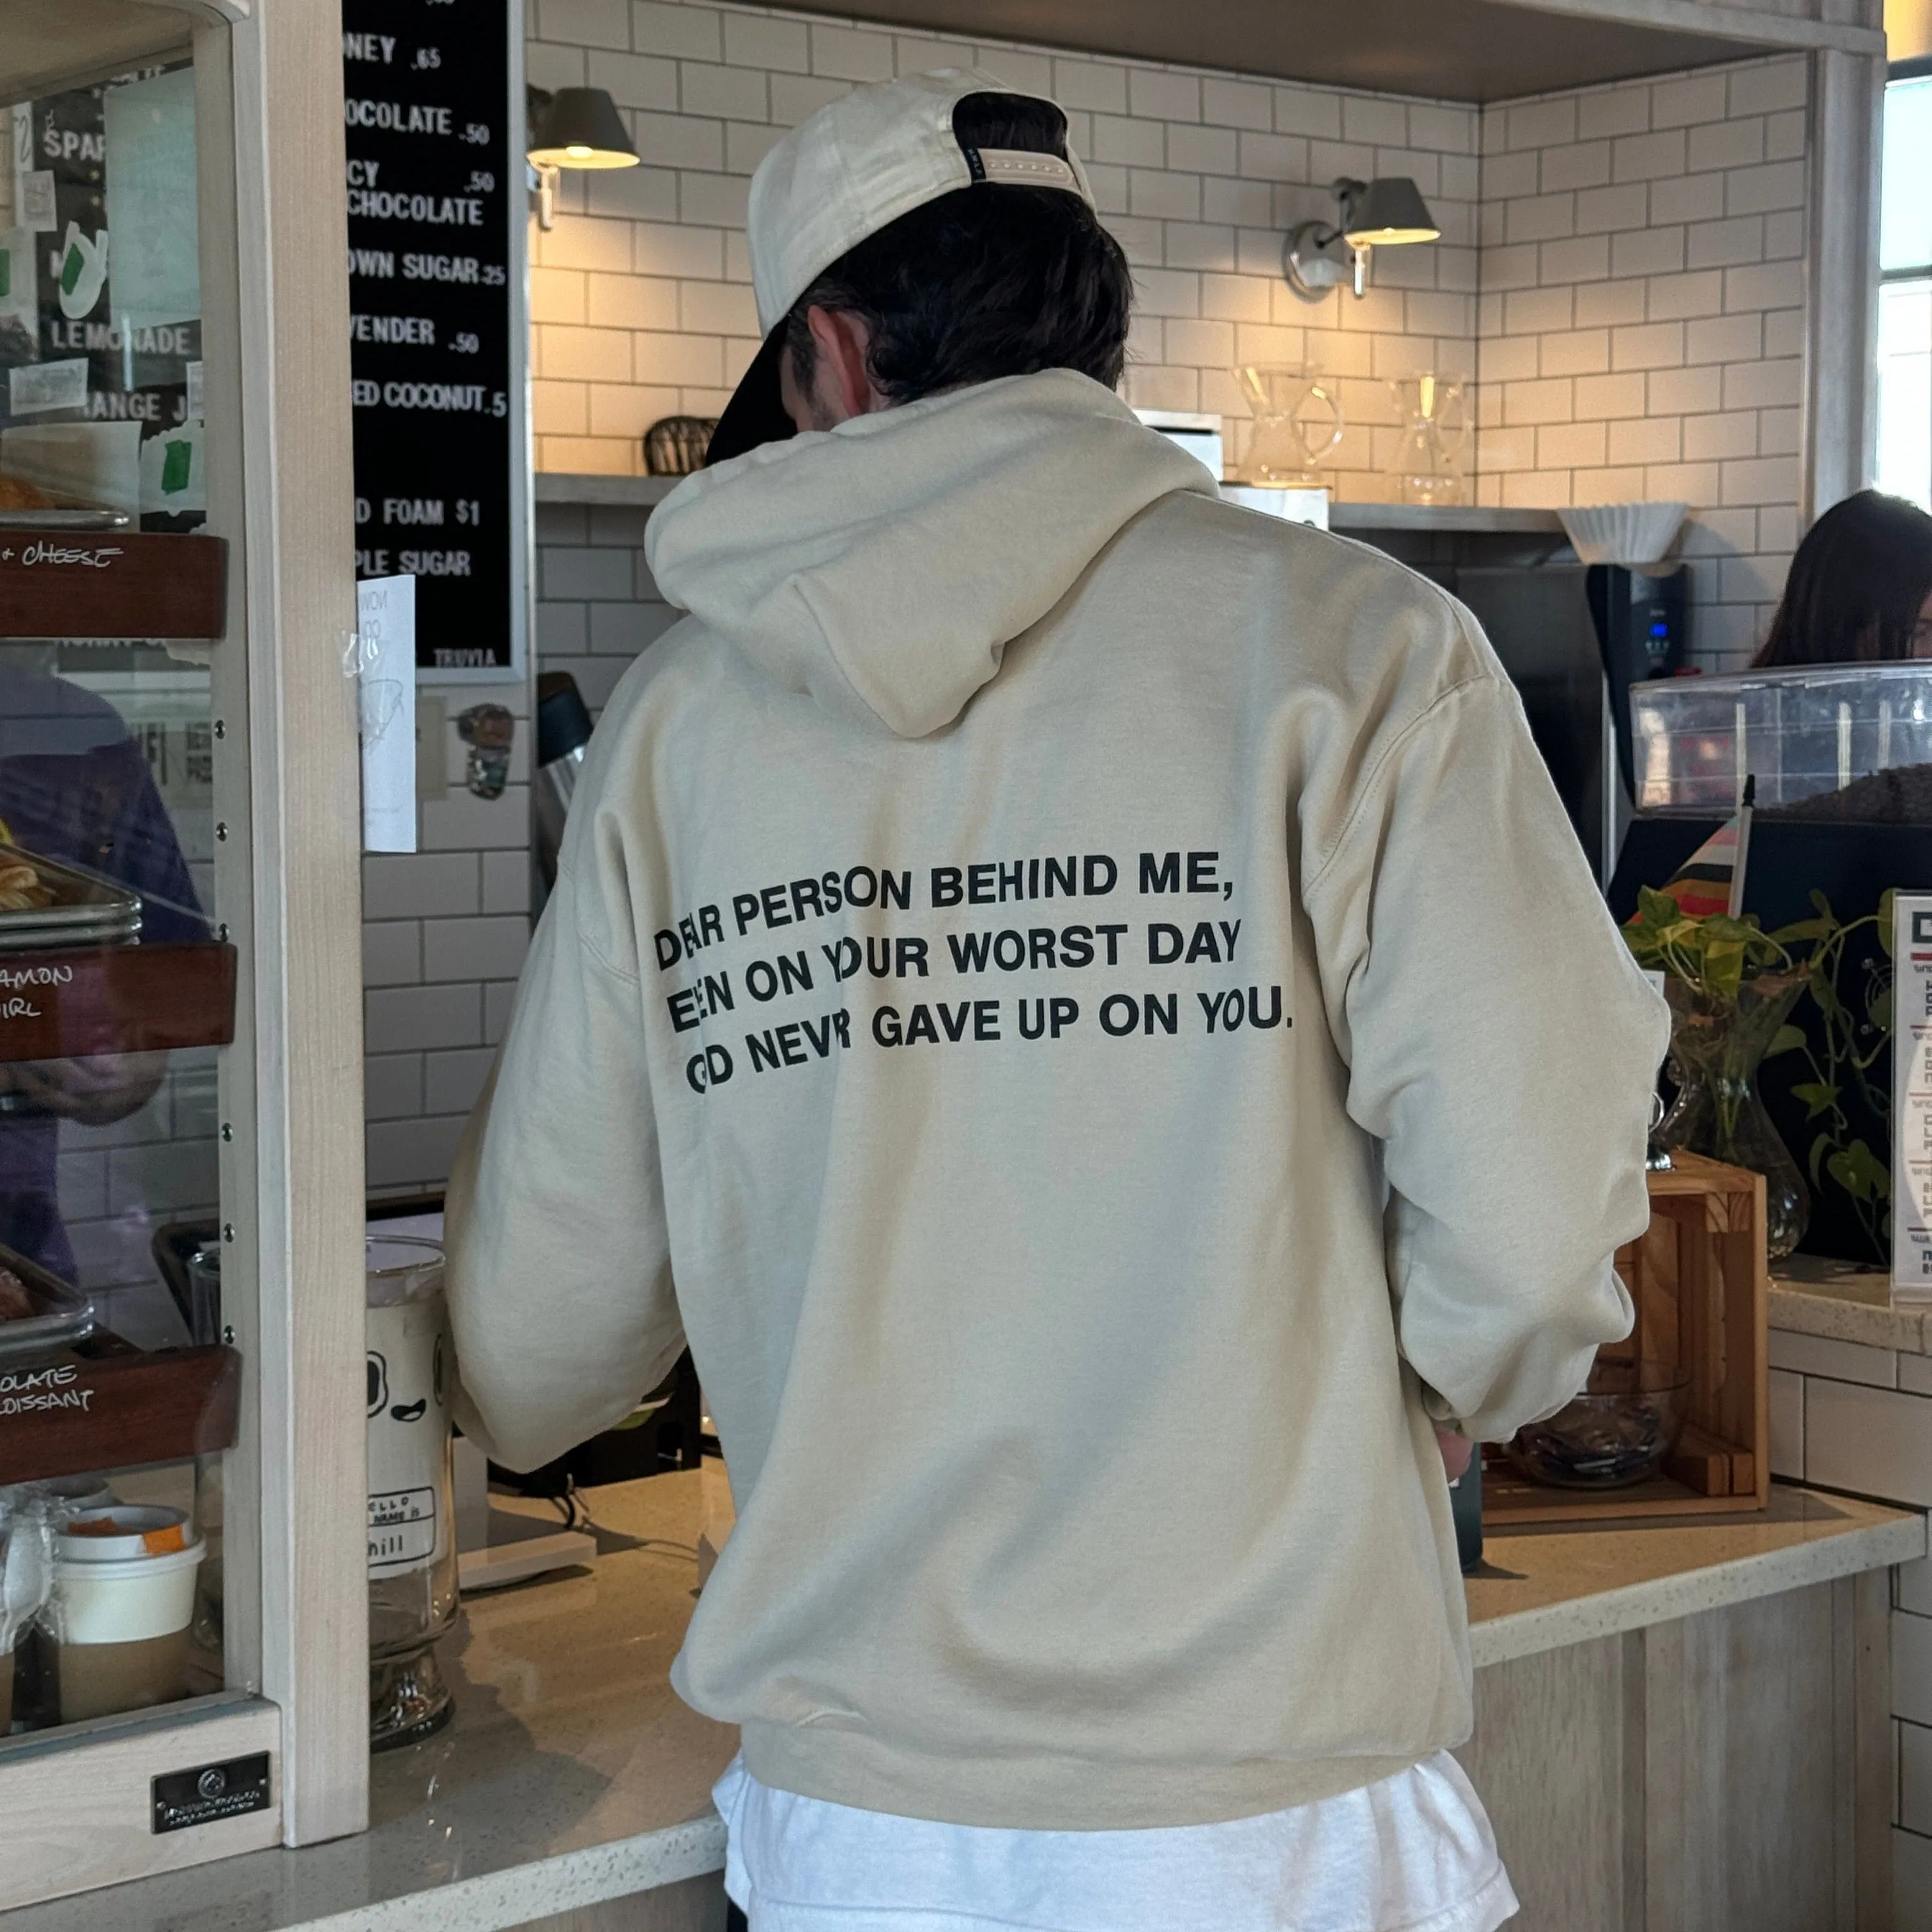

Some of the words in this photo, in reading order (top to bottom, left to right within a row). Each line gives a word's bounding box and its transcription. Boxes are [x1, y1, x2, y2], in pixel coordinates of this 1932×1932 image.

[345, 98, 452, 135] OCOLATE
[347, 158, 380, 188] CY
[347, 188, 484, 226] CHOCOLATE
[402, 252, 479, 284] SUGAR
[84, 390, 161, 421] ANGE
[383, 380, 487, 412] COCONUT
[383, 497, 444, 526] FOAM
[456, 498, 480, 526] $1
[22, 540, 124, 567] CHEESE
[398, 549, 471, 577] SUGAR
[733, 866, 912, 936] PERSON
[931, 854, 1117, 908] BEHIND
[1138, 852, 1233, 901] ME,
[666, 970, 735, 1034] EN
[745, 950, 815, 1002] ON
[821, 936, 930, 983] YOUR
[946, 924, 1128, 974] WORST
[1147, 919, 1241, 965] DAY
[745, 1008, 851, 1073] NEVR
[872, 1000, 1000, 1048] GAVE
[1018, 997, 1080, 1041] UP
[1099, 993, 1178, 1037] ON
[1197, 986, 1292, 1033] YOU.
[0, 1389, 95, 1415] OISSANT
